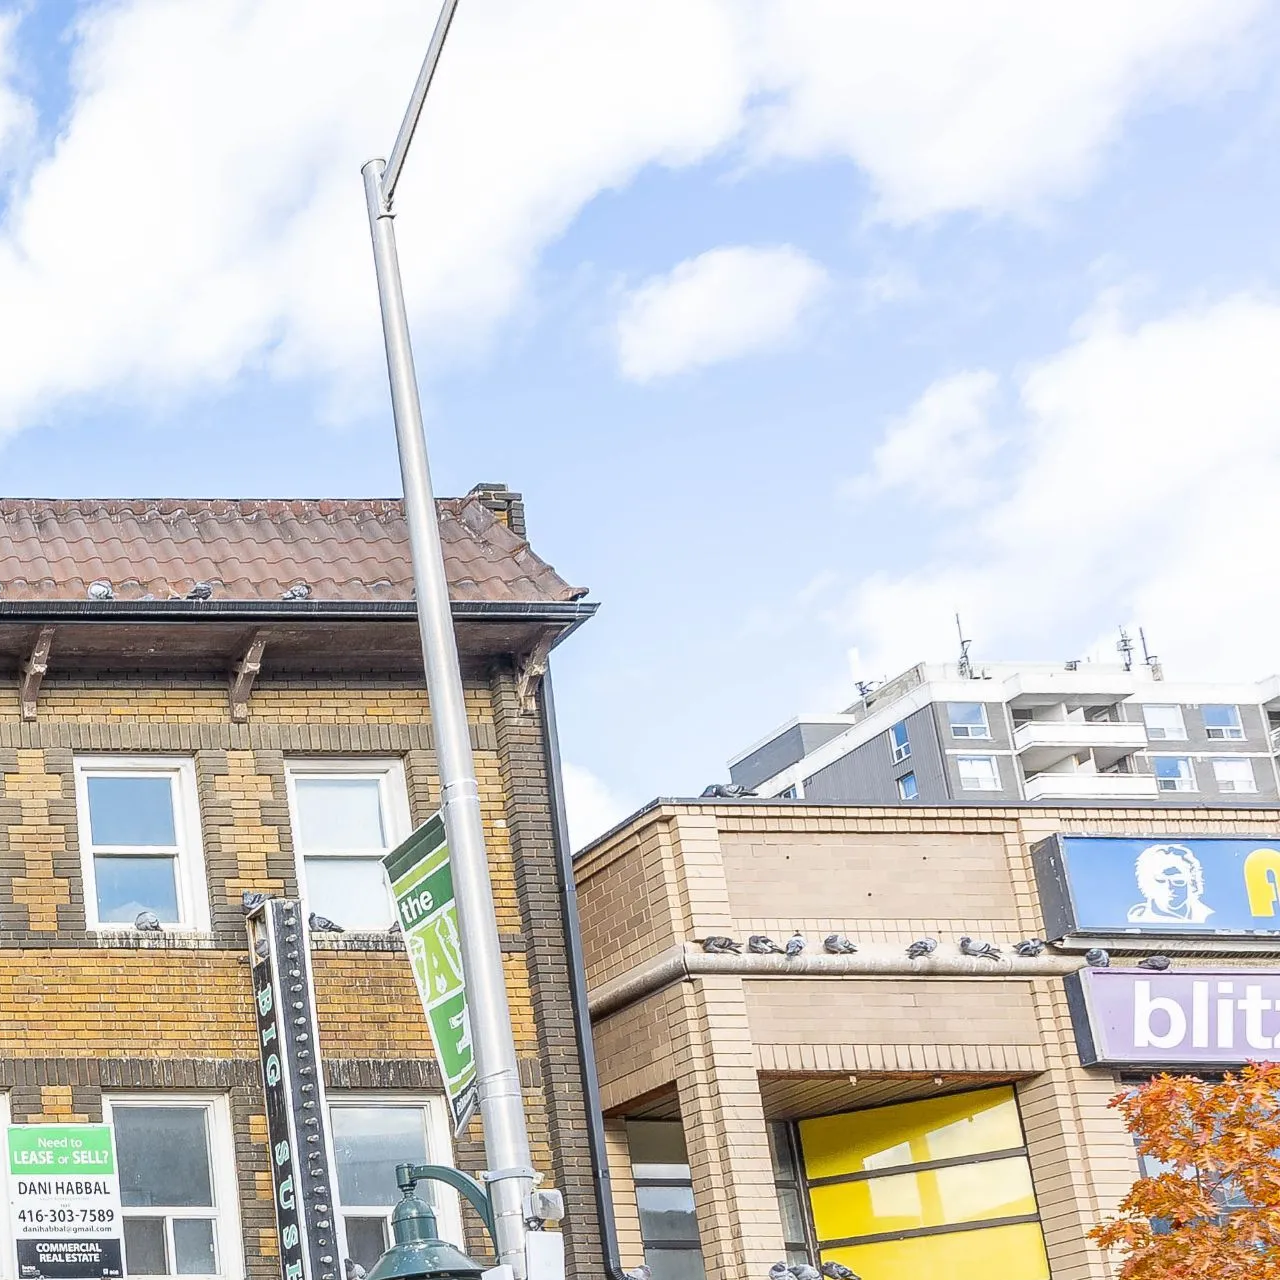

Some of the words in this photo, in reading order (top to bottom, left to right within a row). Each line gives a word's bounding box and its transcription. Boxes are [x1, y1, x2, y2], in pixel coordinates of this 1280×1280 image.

[400, 889, 434, 925] the
[257, 982, 281, 1087] BIG
[37, 1137, 68, 1148] Need
[70, 1138, 82, 1148] to
[13, 1151, 54, 1164] LEASE
[58, 1156, 69, 1164] or
[72, 1151, 109, 1164] SELL?
[18, 1182, 52, 1195] DANI
[56, 1182, 110, 1195] HABBAL
[18, 1209, 114, 1222] 416-303-7589
[22, 1226, 112, 1234] danihabbal@gmail.com
[36, 1243, 102, 1252] COMMERCIAL
[40, 1253, 64, 1263] REAL
[66, 1253, 100, 1262] ESTATE
